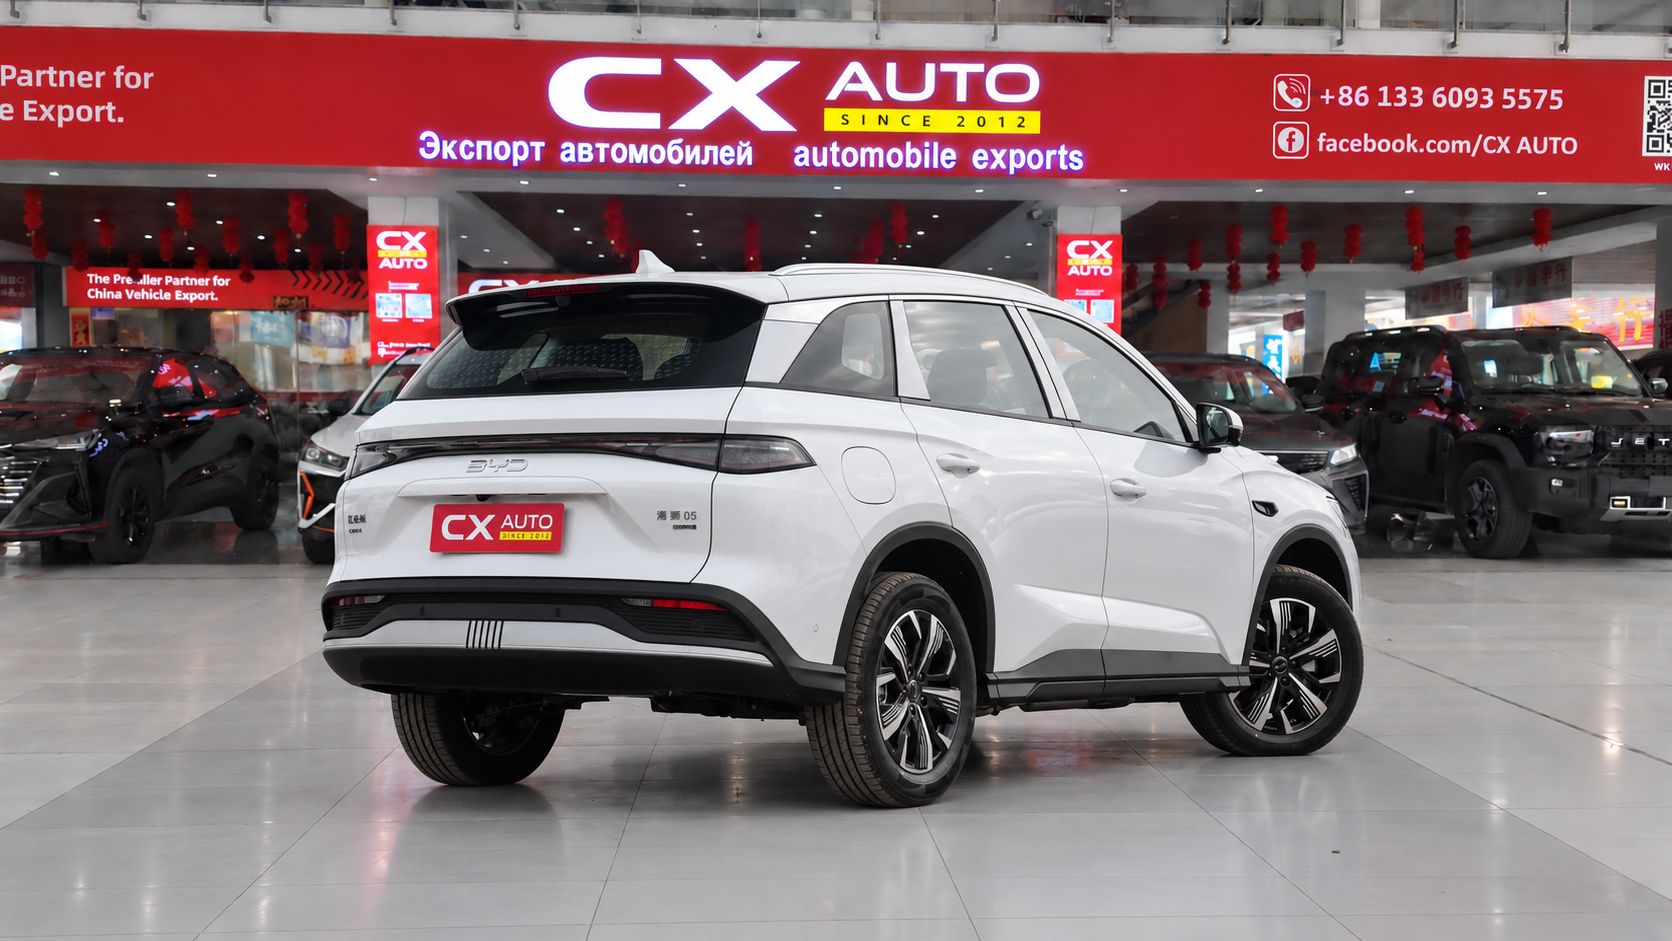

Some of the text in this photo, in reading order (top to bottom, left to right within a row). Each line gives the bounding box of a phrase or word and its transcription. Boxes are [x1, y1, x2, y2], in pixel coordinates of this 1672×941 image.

[0, 64, 155, 90] Partner for
[825, 61, 1041, 103] AUTO
[548, 56, 801, 132] CX
[1320, 85, 1564, 111] +86 133 6093 5575
[23, 99, 125, 128] Export.
[840, 113, 1027, 129] SINCE 2012
[418, 130, 754, 167] Экспорт автомобилей
[1317, 132, 1579, 157] facebook.com/CX AUTO
[793, 140, 1085, 175] automobile exports
[376, 231, 427, 251] CX
[1066, 240, 1113, 259] CX
[378, 258, 428, 269] AUTO
[1067, 265, 1113, 276] AUTO
[86, 273, 110, 284] The
[164, 275, 211, 287] Partner
[212, 275, 232, 287] for
[86, 287, 219, 303] China Vehicle Export.
[466, 458, 528, 473] BYD
[500, 514, 553, 529] AUTO
[683, 511, 697, 521] 05
[441, 514, 496, 540] CX
